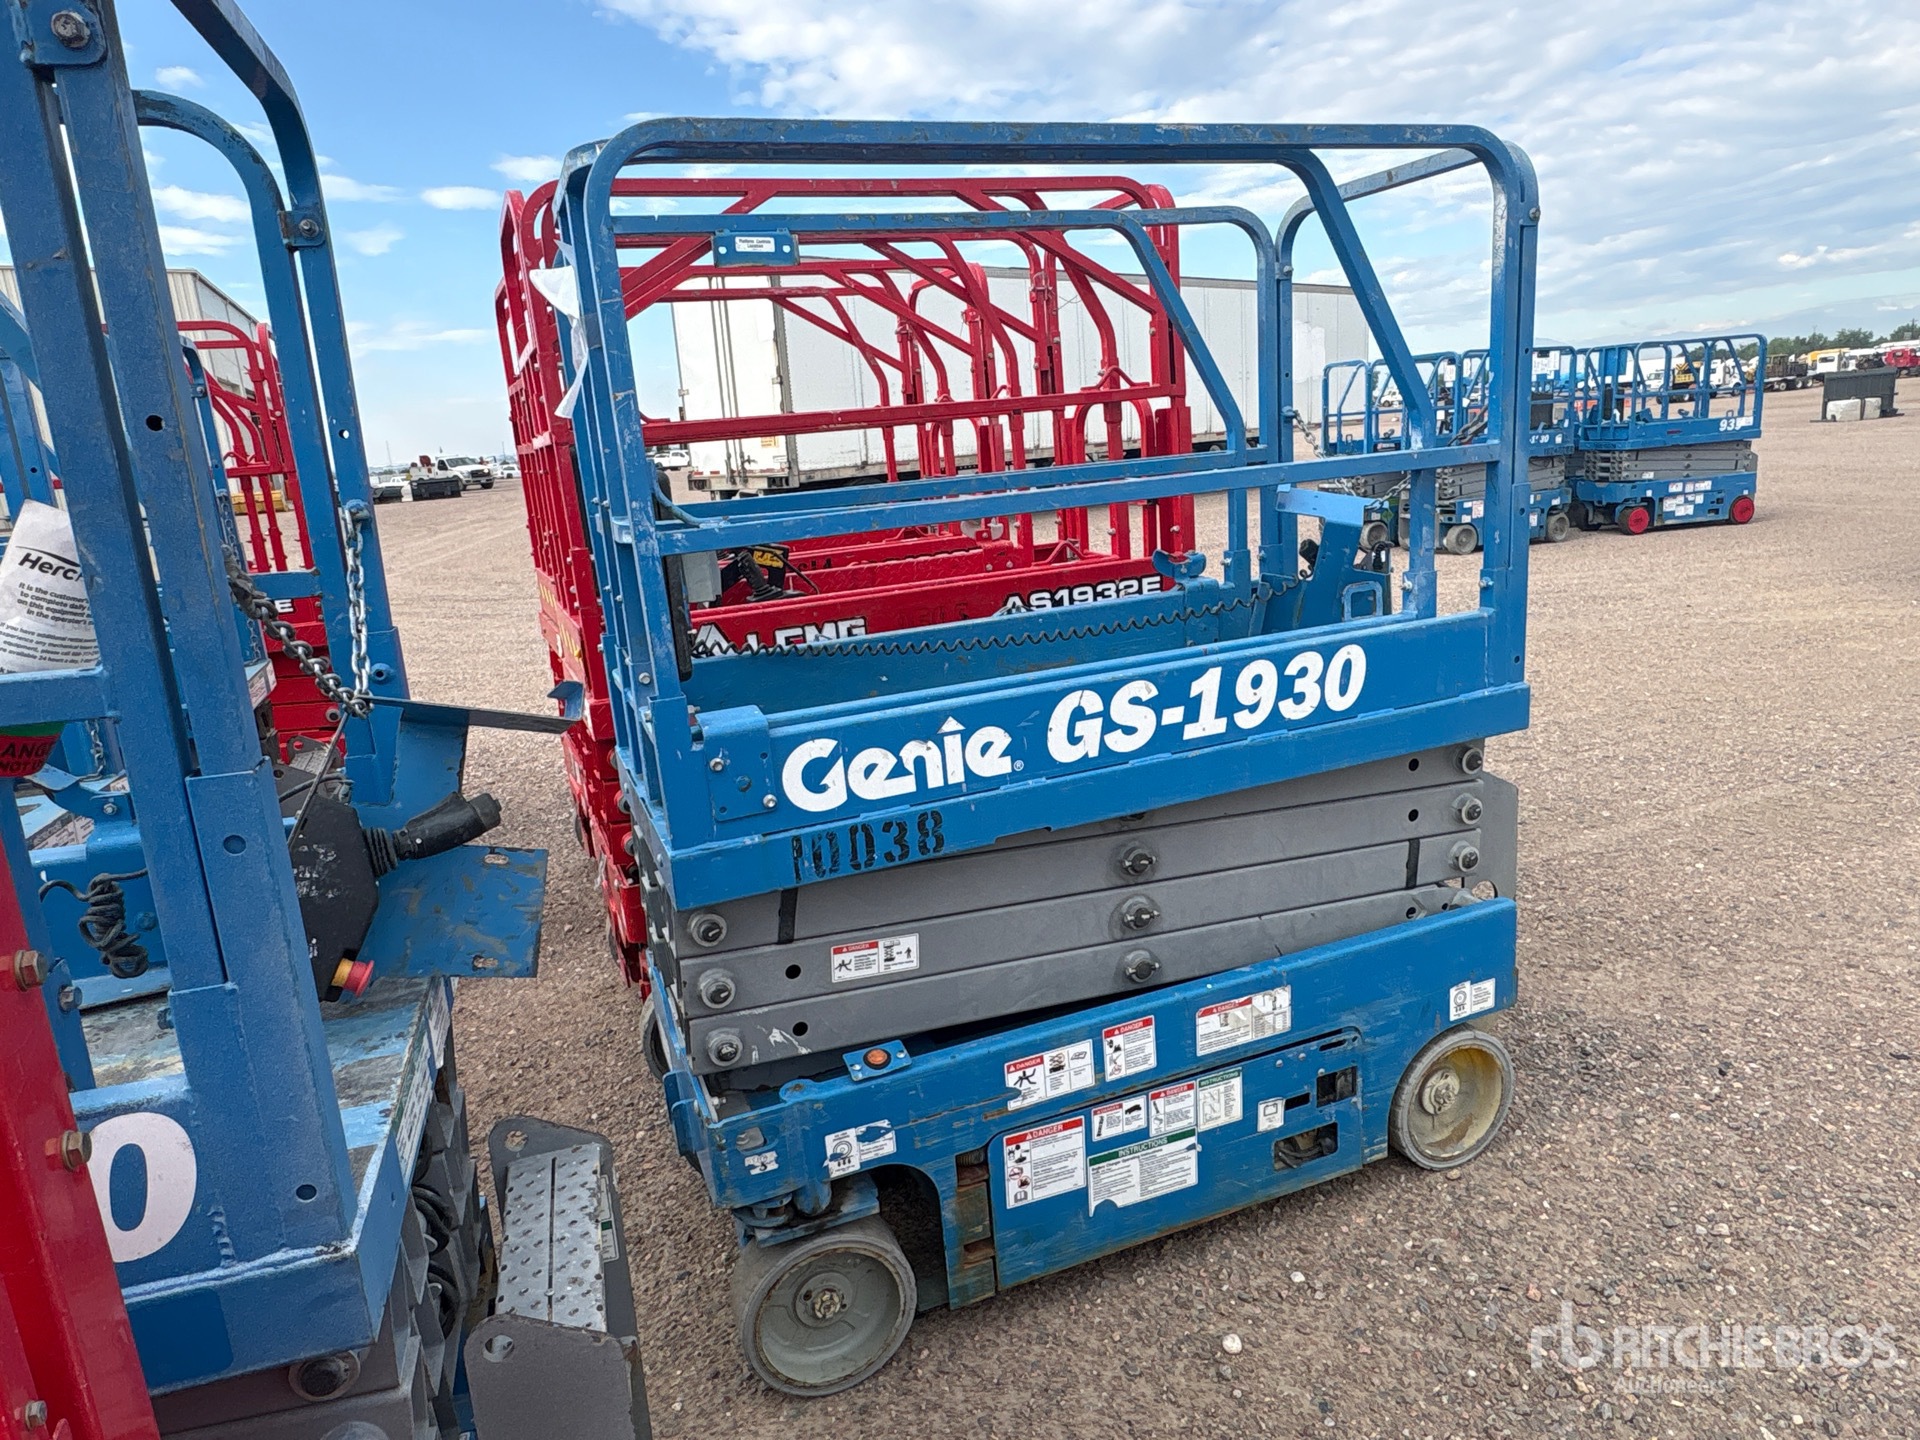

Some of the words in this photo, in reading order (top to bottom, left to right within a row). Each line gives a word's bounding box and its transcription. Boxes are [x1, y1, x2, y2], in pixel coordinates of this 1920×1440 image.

[782, 715, 1012, 812] Genie
[1046, 644, 1366, 763] GS-1930
[848, 943, 870, 951] DANGER
[1120, 1021, 1144, 1034] DANGER
[1016, 1057, 1042, 1070] DANGER
[1166, 1085, 1188, 1095] DANGER
[1032, 1124, 1064, 1138] DANGER
[1118, 1137, 1168, 1157] INSTRUCTIONS
[86, 1112, 197, 1263] 0
